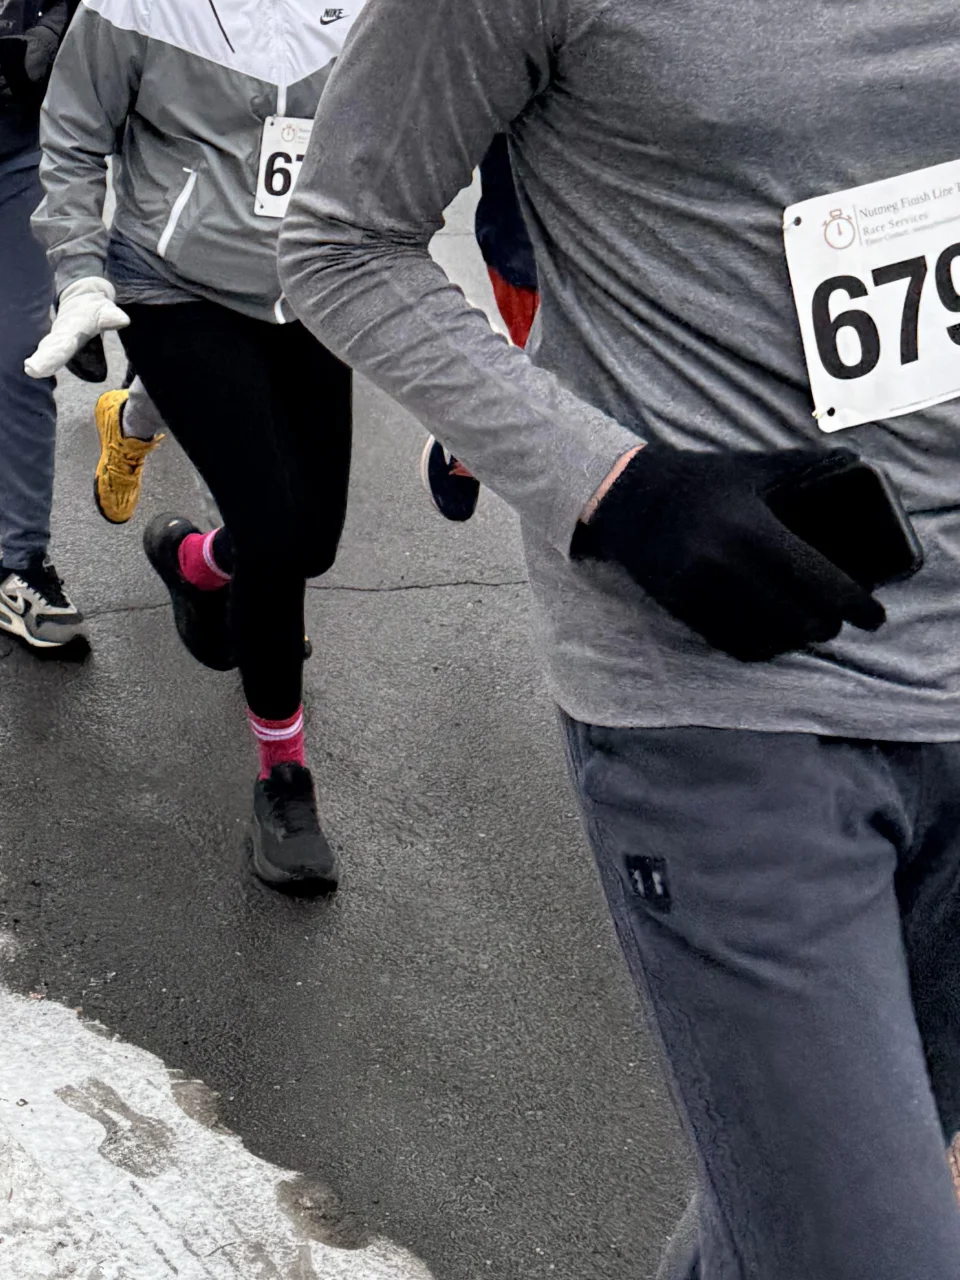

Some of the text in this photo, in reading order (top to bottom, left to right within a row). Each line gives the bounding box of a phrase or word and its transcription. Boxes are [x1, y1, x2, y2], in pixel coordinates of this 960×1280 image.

[323, 7, 345, 19] NIKE
[859, 201, 899, 219] Nutmeg
[900, 192, 931, 209] Finish
[932, 186, 954, 200] Line
[862, 224, 887, 237] Race
[888, 211, 929, 228] Services
